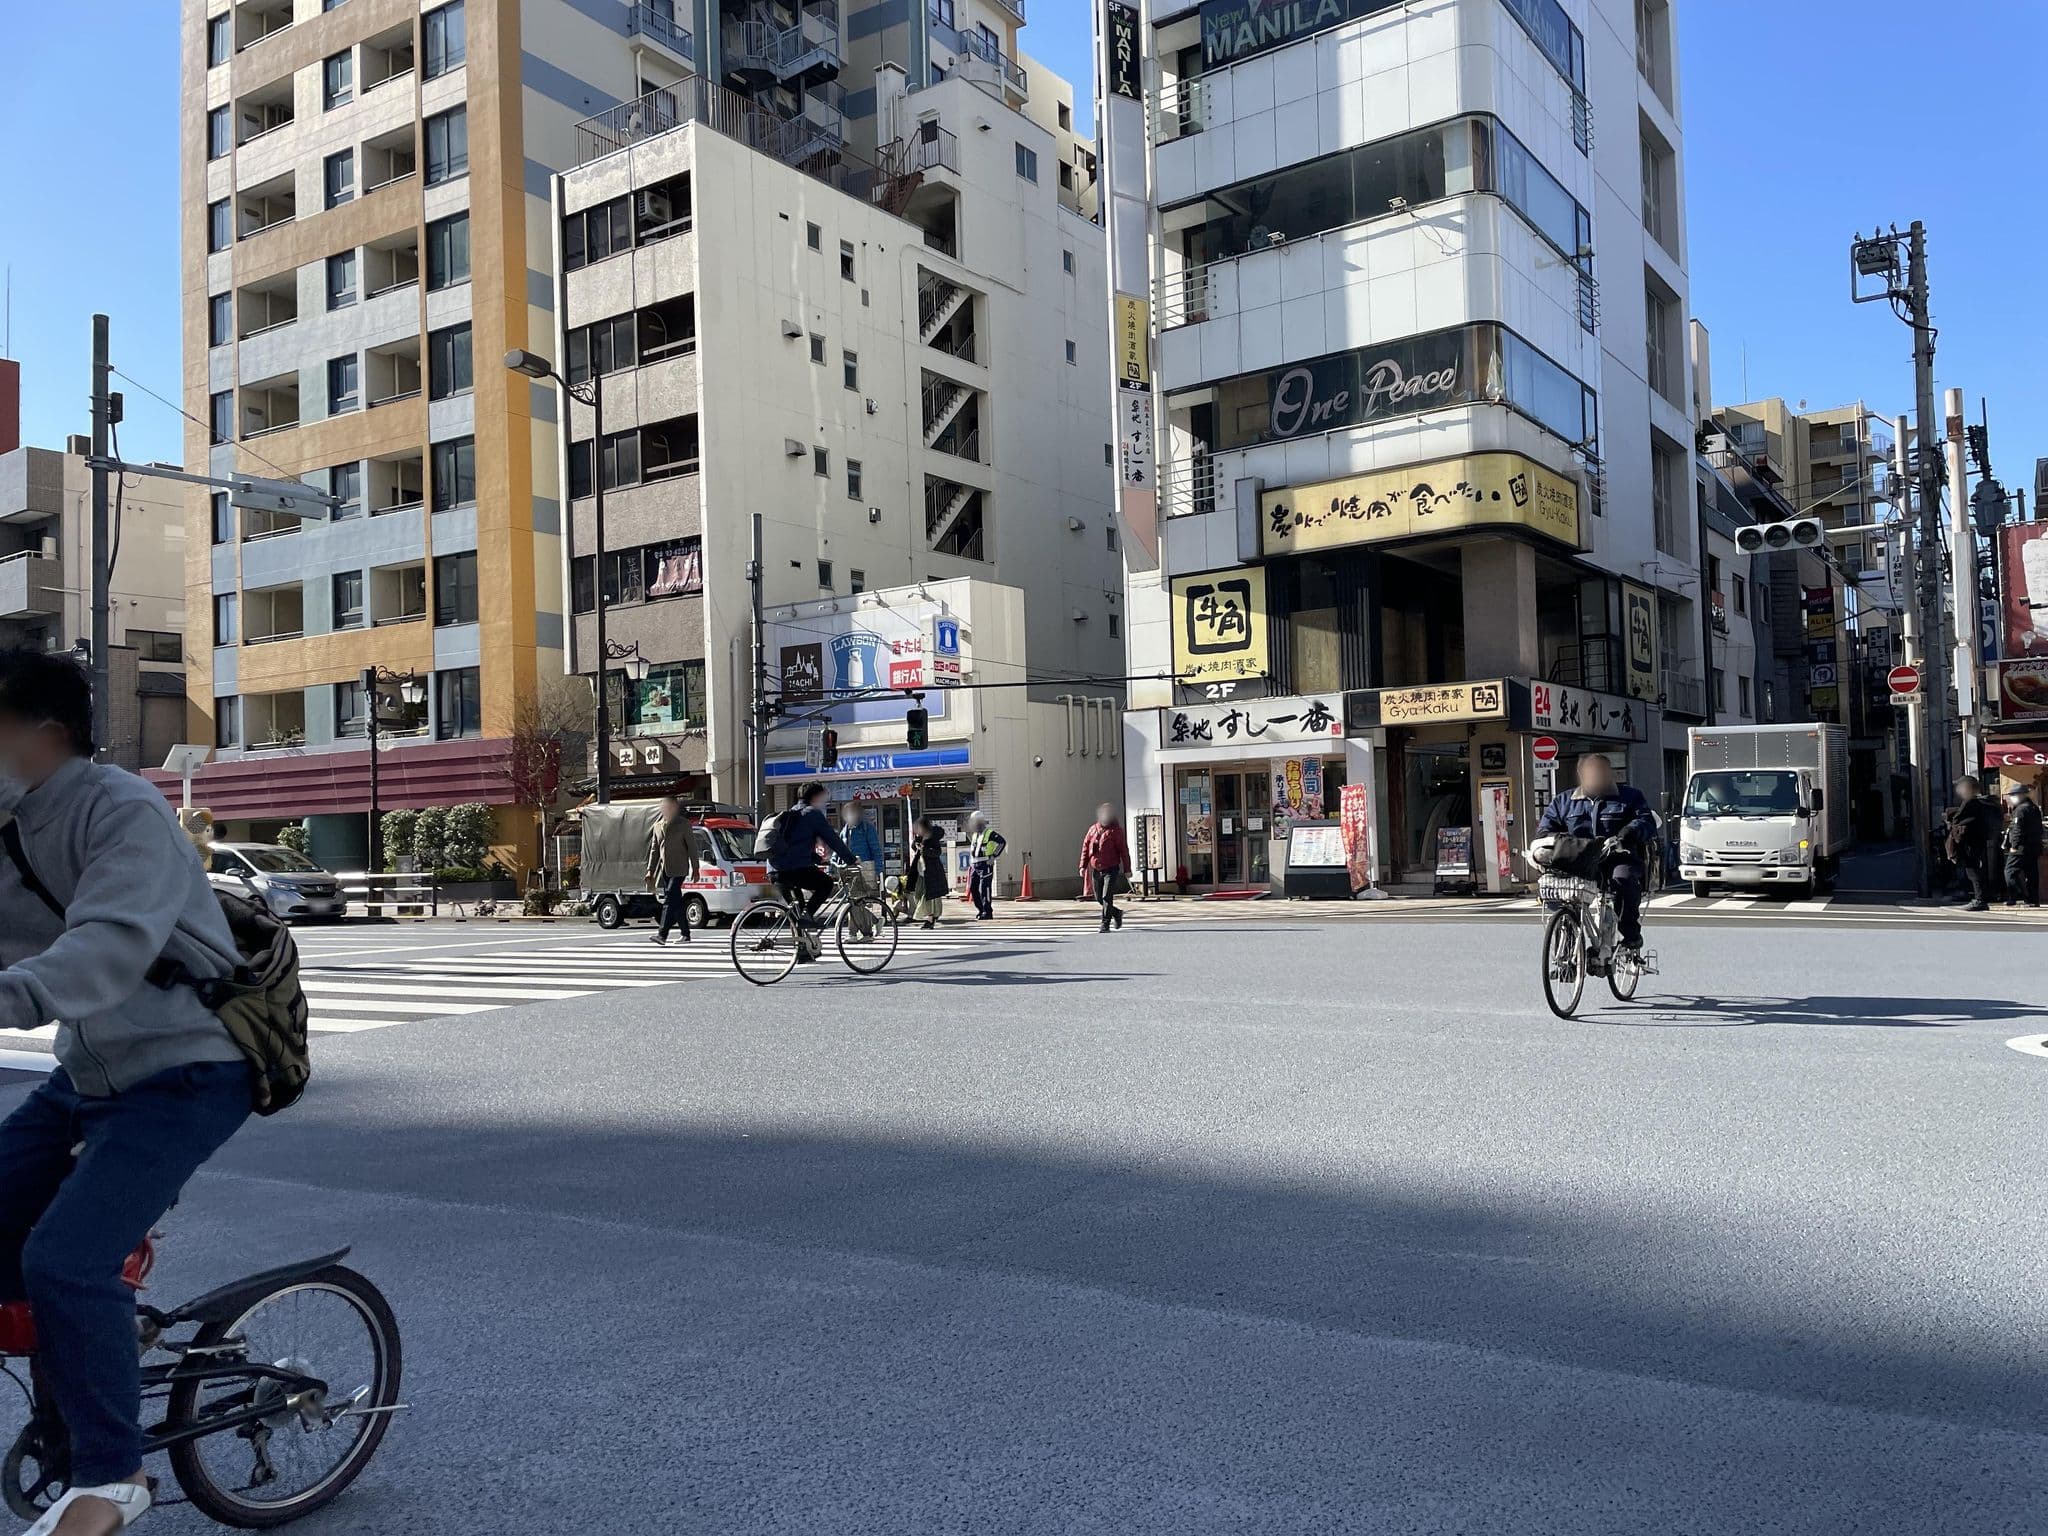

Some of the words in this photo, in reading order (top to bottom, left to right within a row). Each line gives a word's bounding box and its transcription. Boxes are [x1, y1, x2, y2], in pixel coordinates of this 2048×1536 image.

[1206, 8, 1245, 31] New
[1206, 0, 1341, 63] MANILA
[1116, 24, 1133, 97] MANILA
[1129, 381, 1142, 390] 2F
[1271, 367, 1349, 437] One
[834, 636, 877, 651] LAWSON
[789, 678, 813, 688] MACHI
[1206, 683, 1236, 699] 2F
[1389, 702, 1459, 719] Gyu-Kaku
[1535, 685, 1550, 715] 24
[821, 754, 890, 773] AWSON
[2033, 753, 2048, 765] S
[1286, 760, 1302, 809] お持ち帰り
[1303, 757, 1321, 795] 寿司
